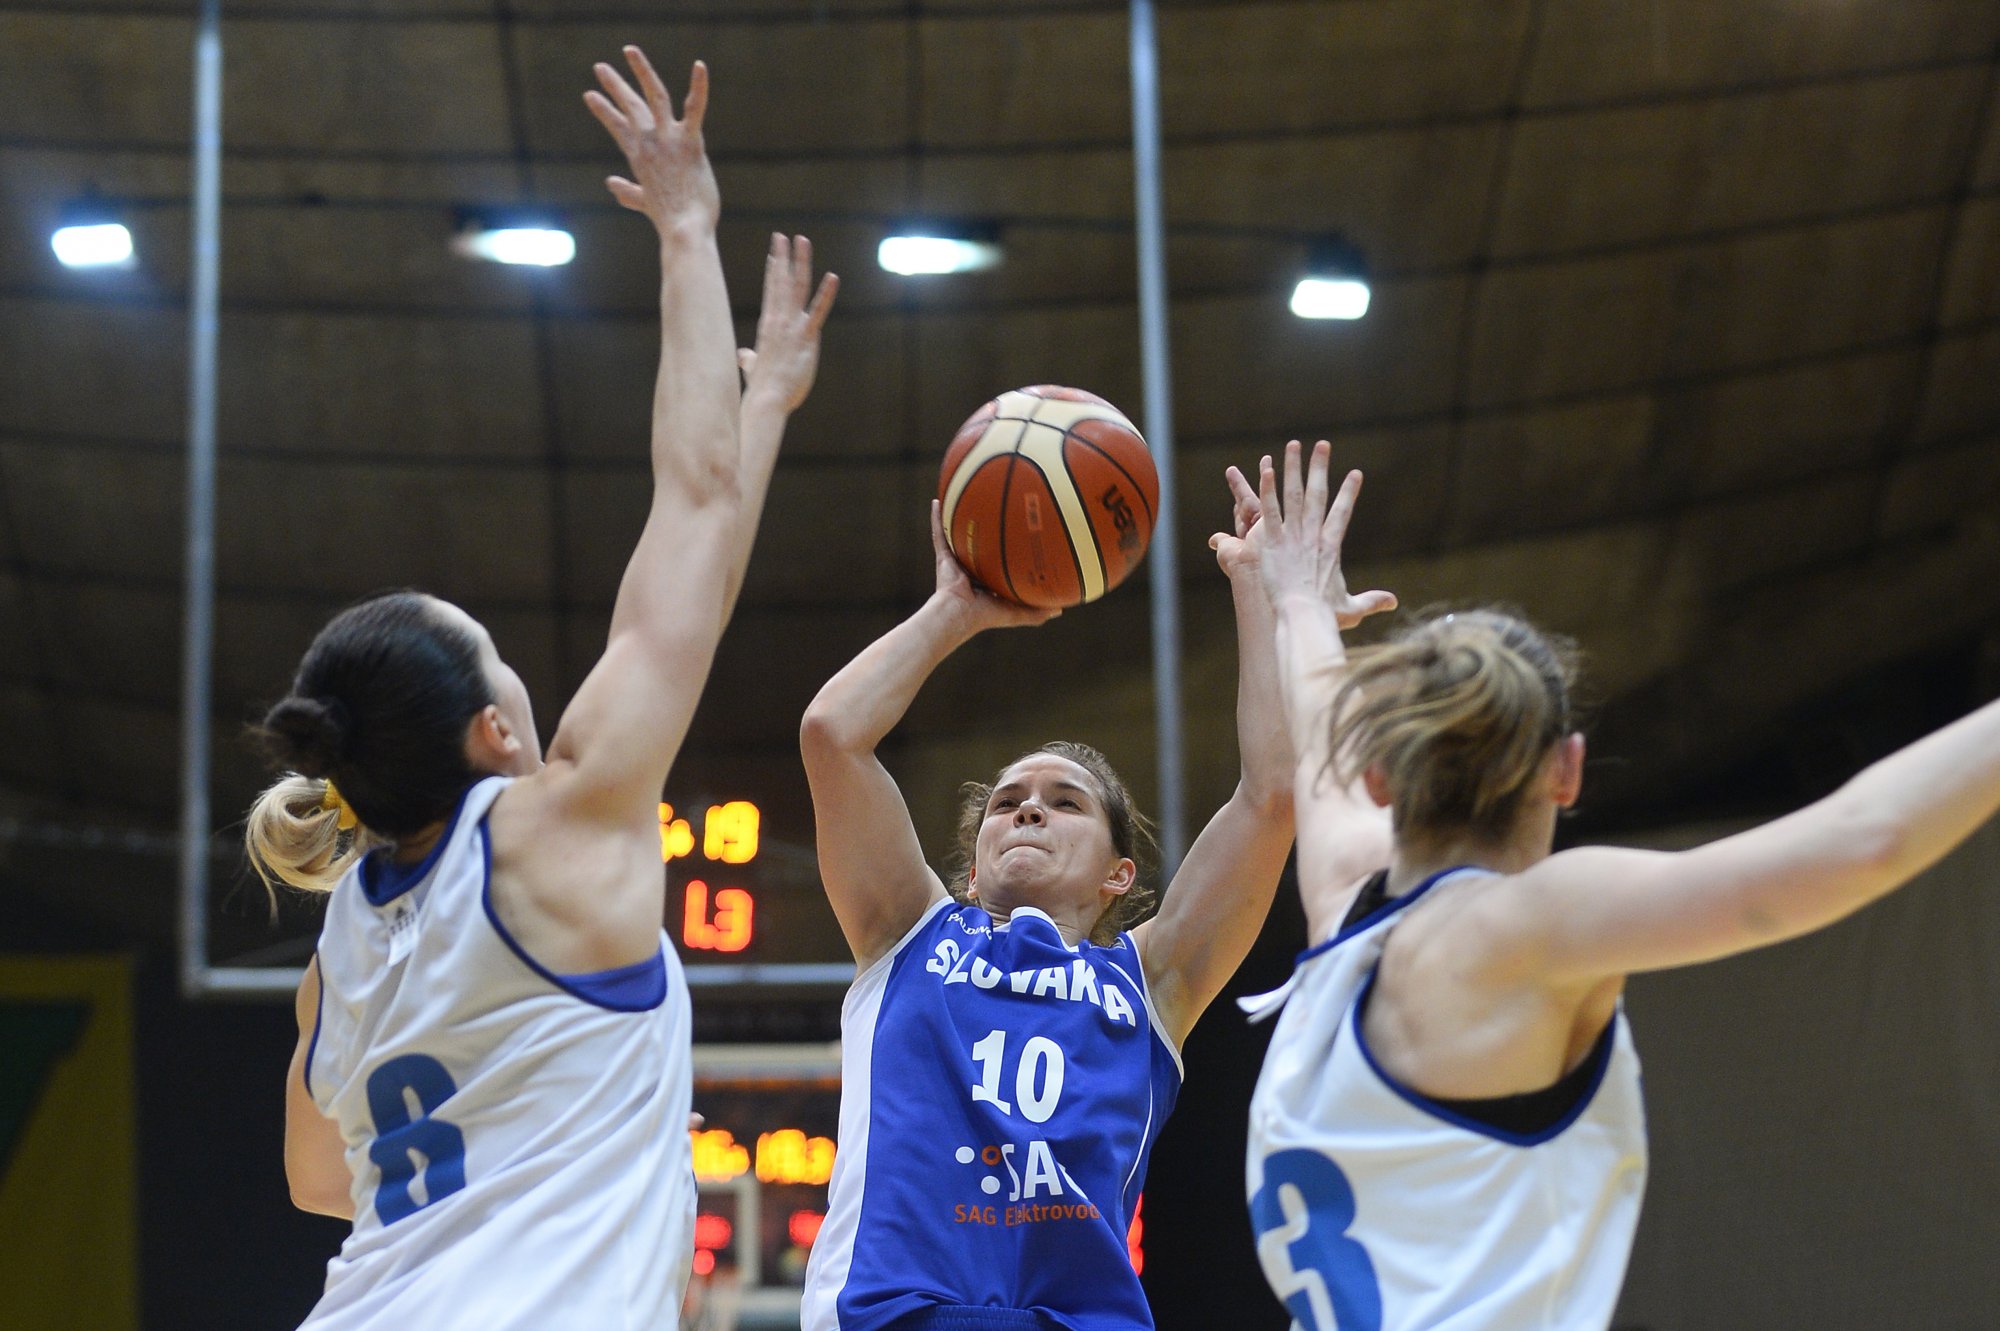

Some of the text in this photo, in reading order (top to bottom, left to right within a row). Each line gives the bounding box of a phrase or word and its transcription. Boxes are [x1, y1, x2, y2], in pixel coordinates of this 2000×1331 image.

[947, 912, 993, 941] PALDING
[926, 938, 1136, 1027] SLOVAKA
[971, 1029, 1065, 1123] 10
[1001, 1140, 1089, 1202] SA
[954, 1203, 997, 1226] SAG
